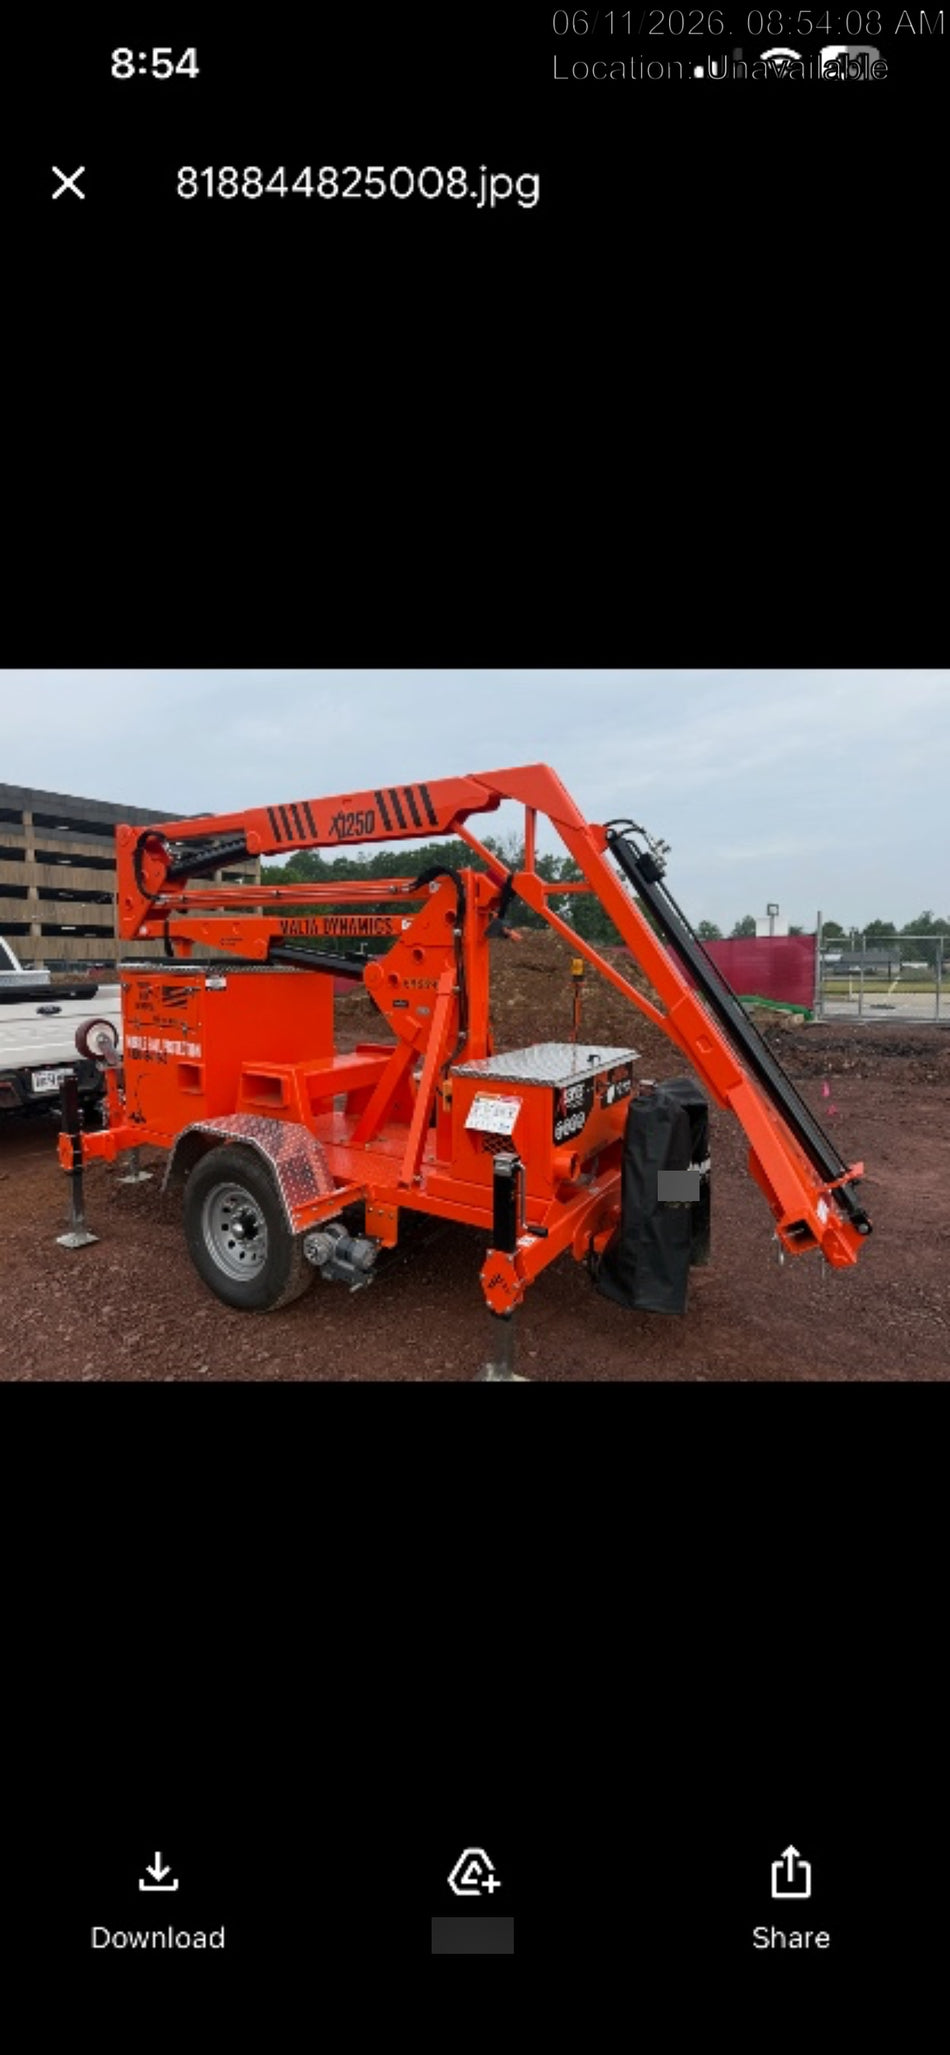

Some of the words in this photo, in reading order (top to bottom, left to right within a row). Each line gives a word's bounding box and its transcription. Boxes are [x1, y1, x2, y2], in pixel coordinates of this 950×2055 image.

[111, 47, 200, 80] 8:54
[176, 164, 540, 209] 818844825008.jpg
[91, 1925, 225, 1949] Download
[752, 1925, 831, 1949] Share
